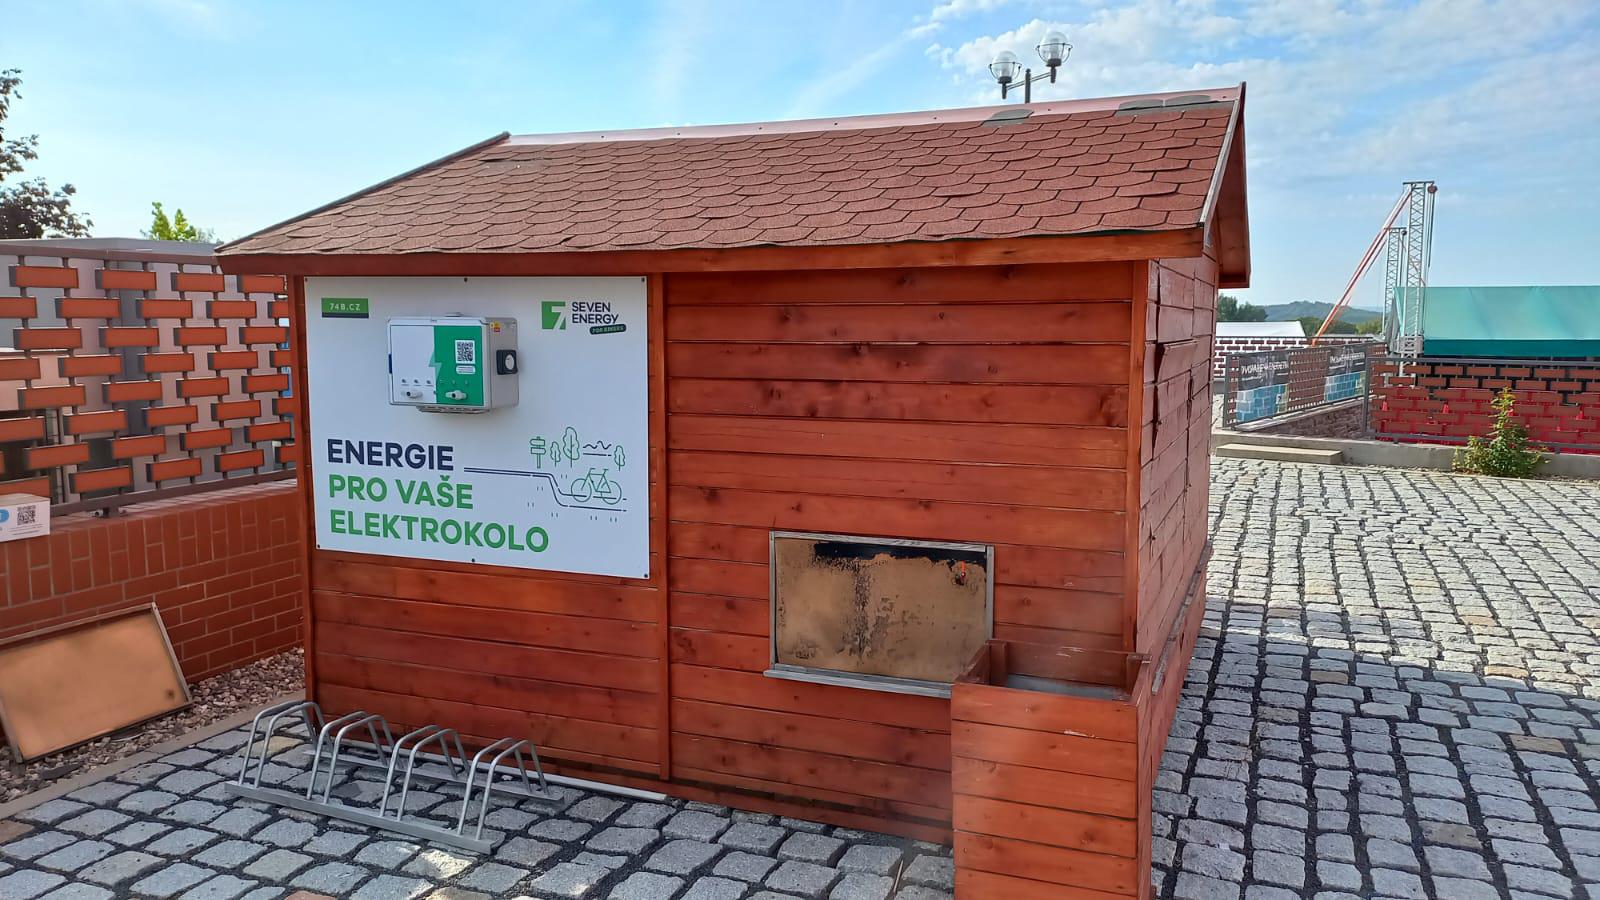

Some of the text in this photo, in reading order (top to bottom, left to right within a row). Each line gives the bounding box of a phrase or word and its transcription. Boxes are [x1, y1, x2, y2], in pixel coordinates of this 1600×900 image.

[572, 313, 619, 324] ENERGY
[327, 438, 454, 471] ENERGIE
[329, 474, 473, 509] PRO VAŠE
[330, 509, 549, 552] ELEKTROKOLO
